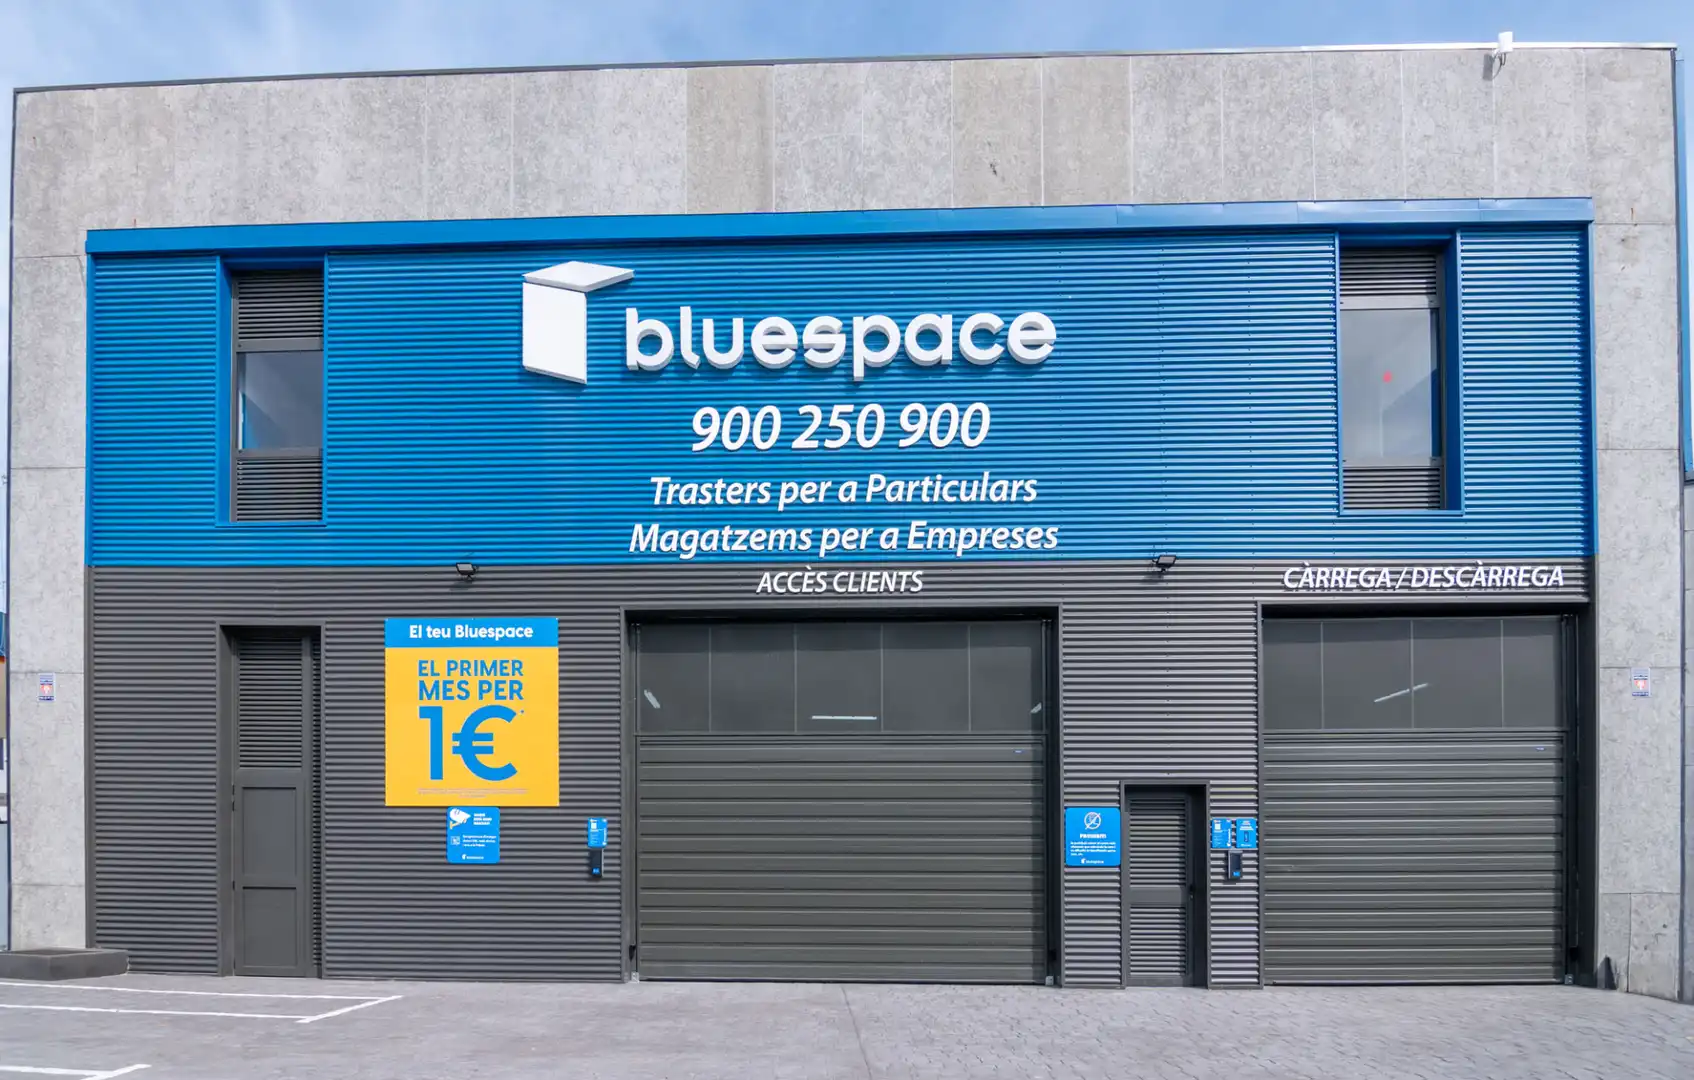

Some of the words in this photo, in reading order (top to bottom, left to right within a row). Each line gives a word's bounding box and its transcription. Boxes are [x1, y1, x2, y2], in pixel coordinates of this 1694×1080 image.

[625, 305, 1057, 379] bluespace
[692, 405, 782, 452] 900
[791, 404, 886, 449] 250
[898, 402, 991, 448] 900
[650, 475, 771, 506] Trasters
[777, 480, 832, 511] per
[838, 481, 858, 503] a
[865, 471, 1038, 503] Particulars
[629, 523, 813, 559] Magatzems
[819, 527, 874, 557] per
[879, 527, 900, 550] a
[907, 520, 1059, 557] Empreses
[756, 565, 828, 594] ACCÈS
[833, 570, 924, 594] CLIENTS
[1283, 561, 1392, 589] CÀRREGA
[1410, 560, 1565, 588] DESCÀRREGA
[409, 625, 423, 639] El
[426, 626, 451, 639] teu
[455, 625, 534, 641] Bluespace
[417, 659, 440, 677] EL
[446, 659, 523, 677] PRIMER
[418, 680, 471, 701] MES
[478, 680, 523, 701] PER
